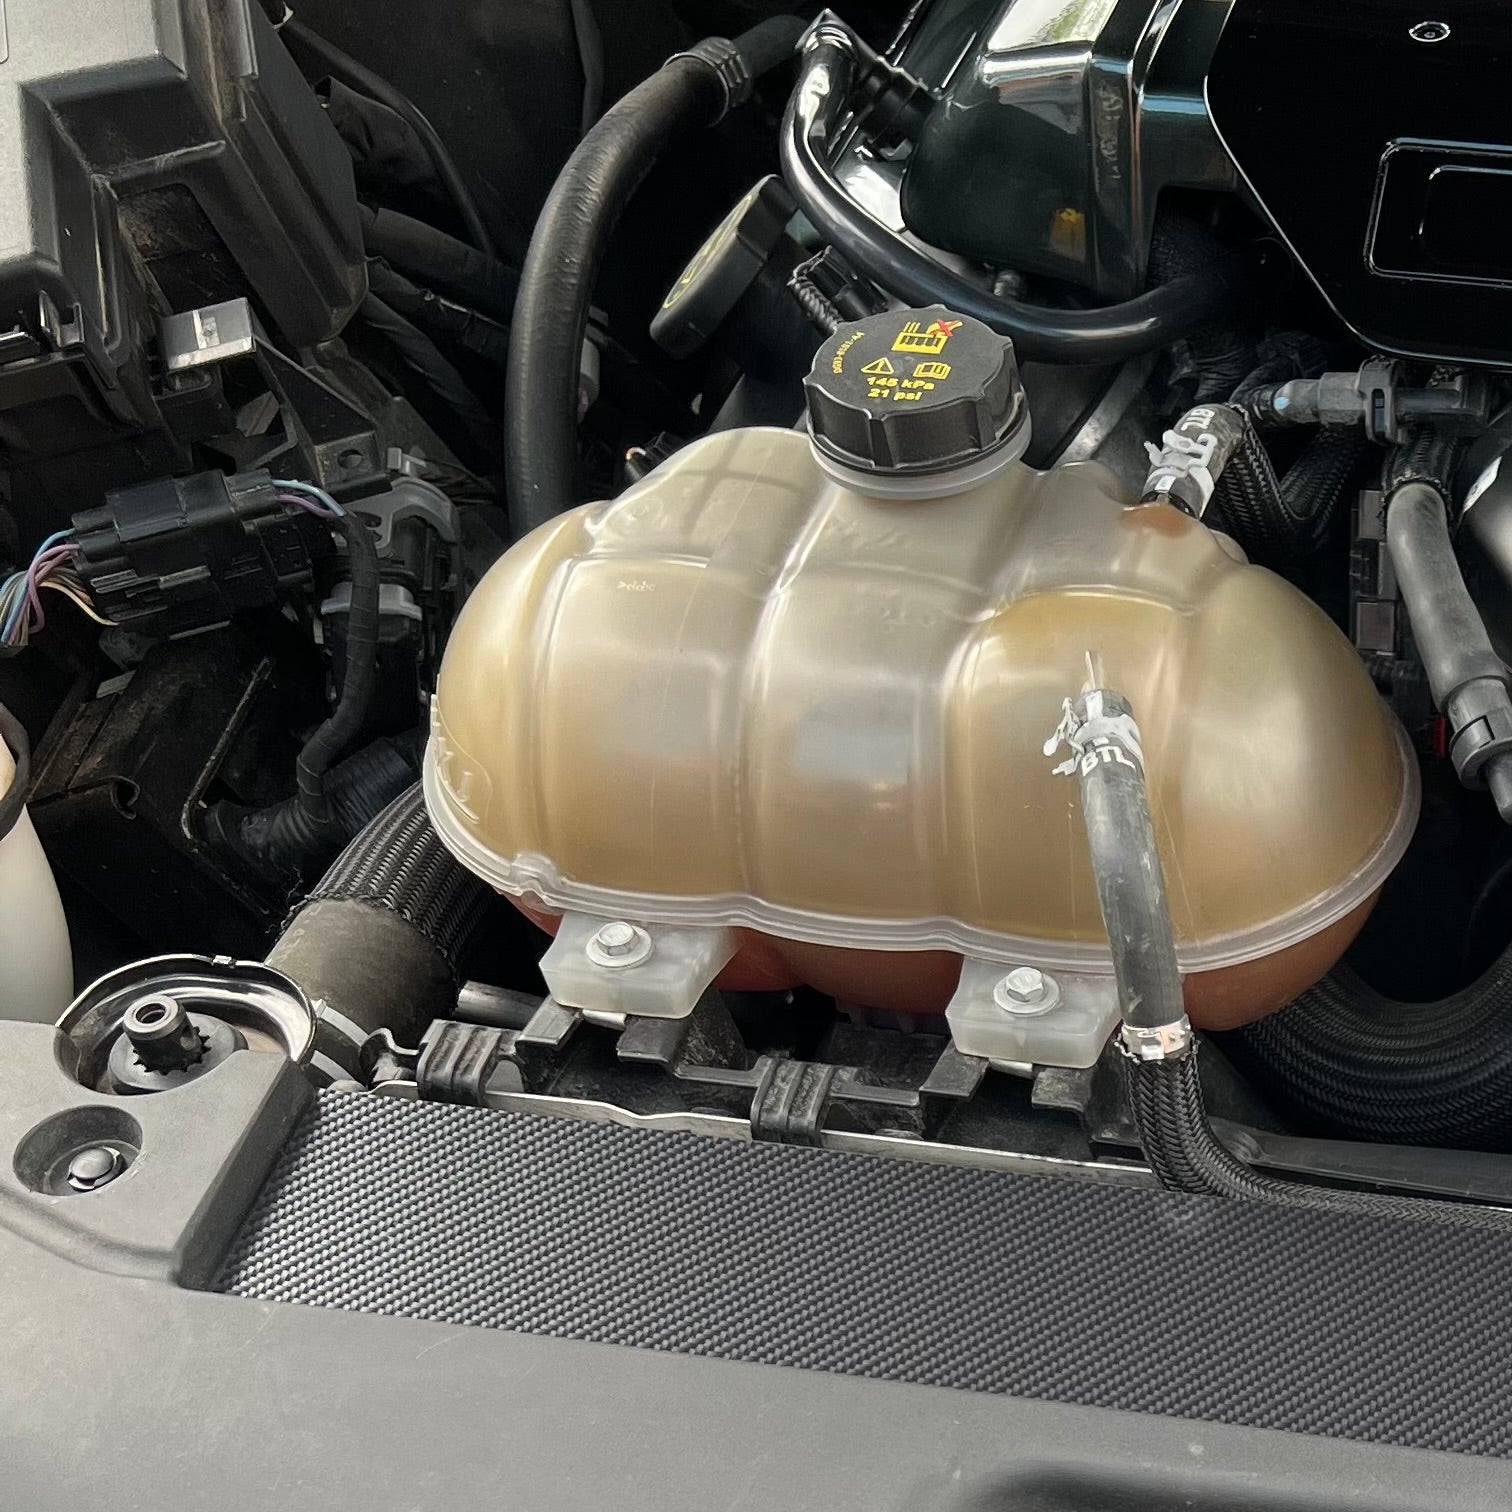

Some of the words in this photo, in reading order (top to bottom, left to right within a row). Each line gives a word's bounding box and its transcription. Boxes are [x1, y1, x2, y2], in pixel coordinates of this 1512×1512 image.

[867, 376, 899, 387] 145
[901, 379, 935, 390] kPa
[867, 388, 890, 398] 21
[893, 391, 923, 401] psi
[1081, 745, 1136, 776] BTL
